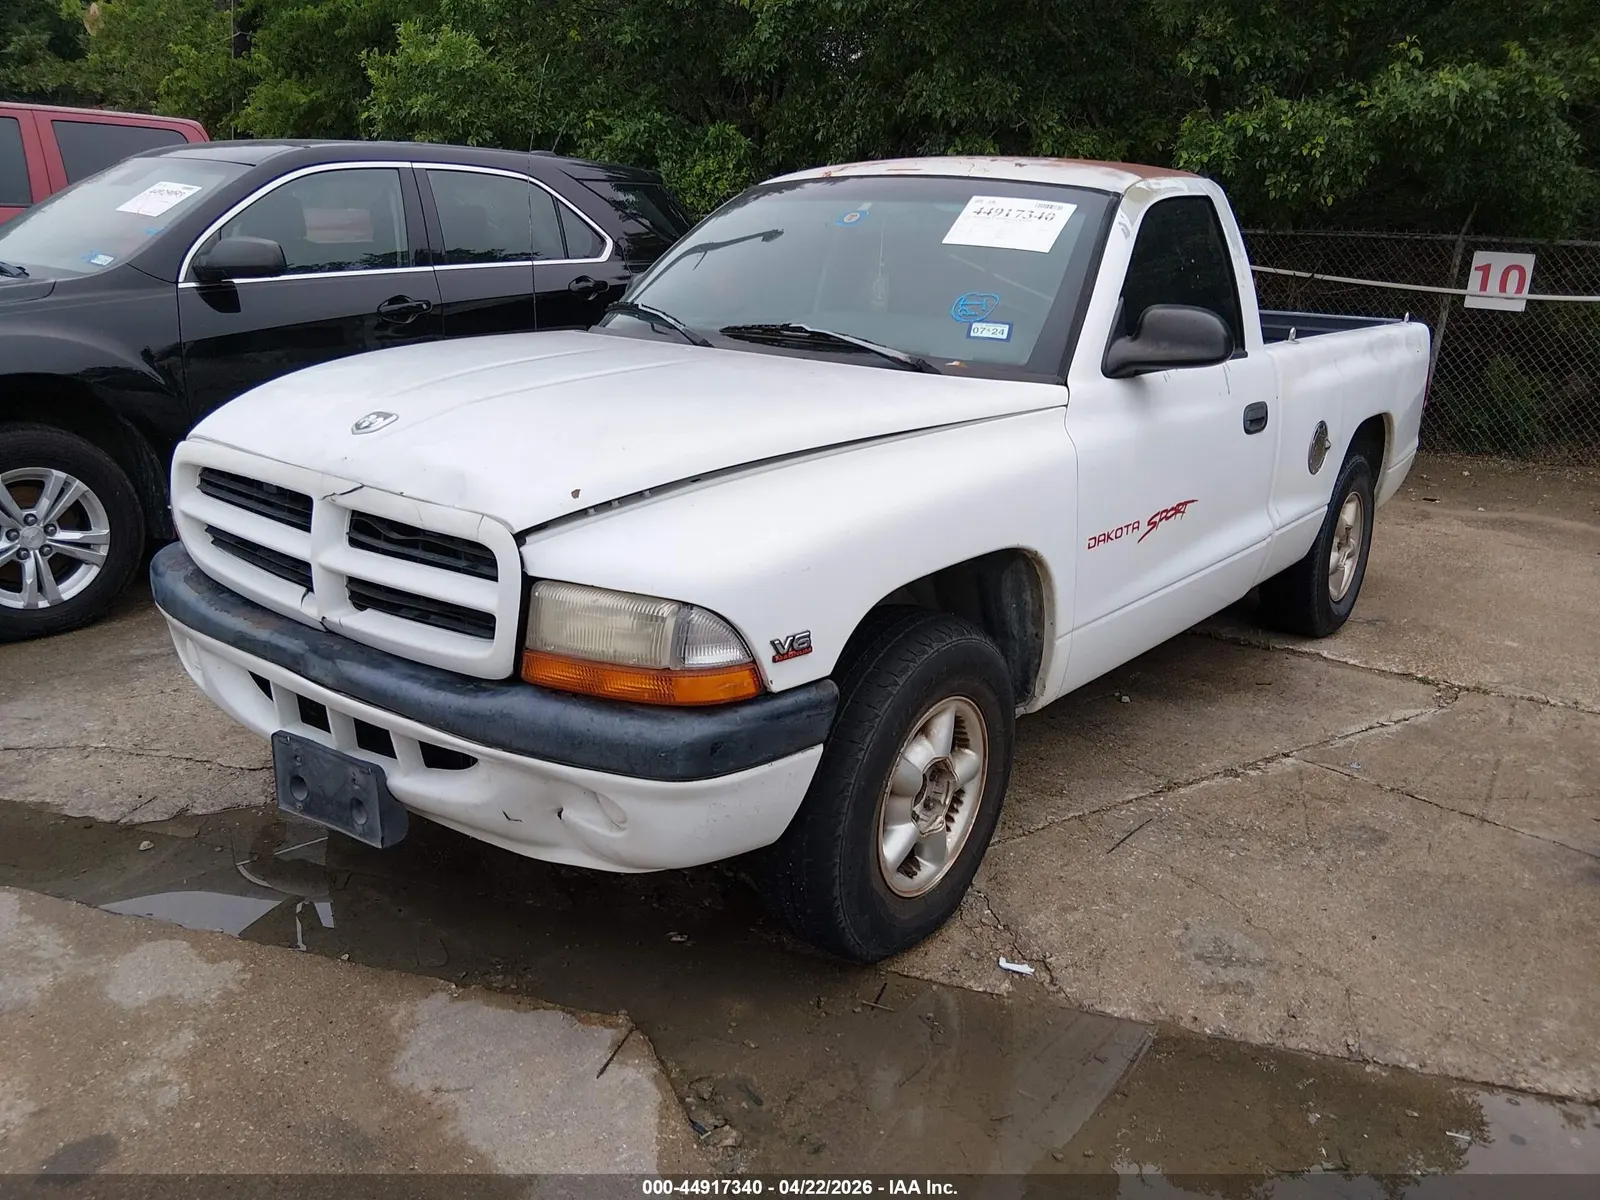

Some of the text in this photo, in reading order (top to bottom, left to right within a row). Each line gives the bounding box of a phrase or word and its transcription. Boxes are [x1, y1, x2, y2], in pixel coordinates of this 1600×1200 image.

[973, 206, 1056, 222] 44917340
[1474, 263, 1527, 295] 10
[1087, 499, 1198, 550] DAKOTA SPORT
[770, 630, 811, 655] V6
